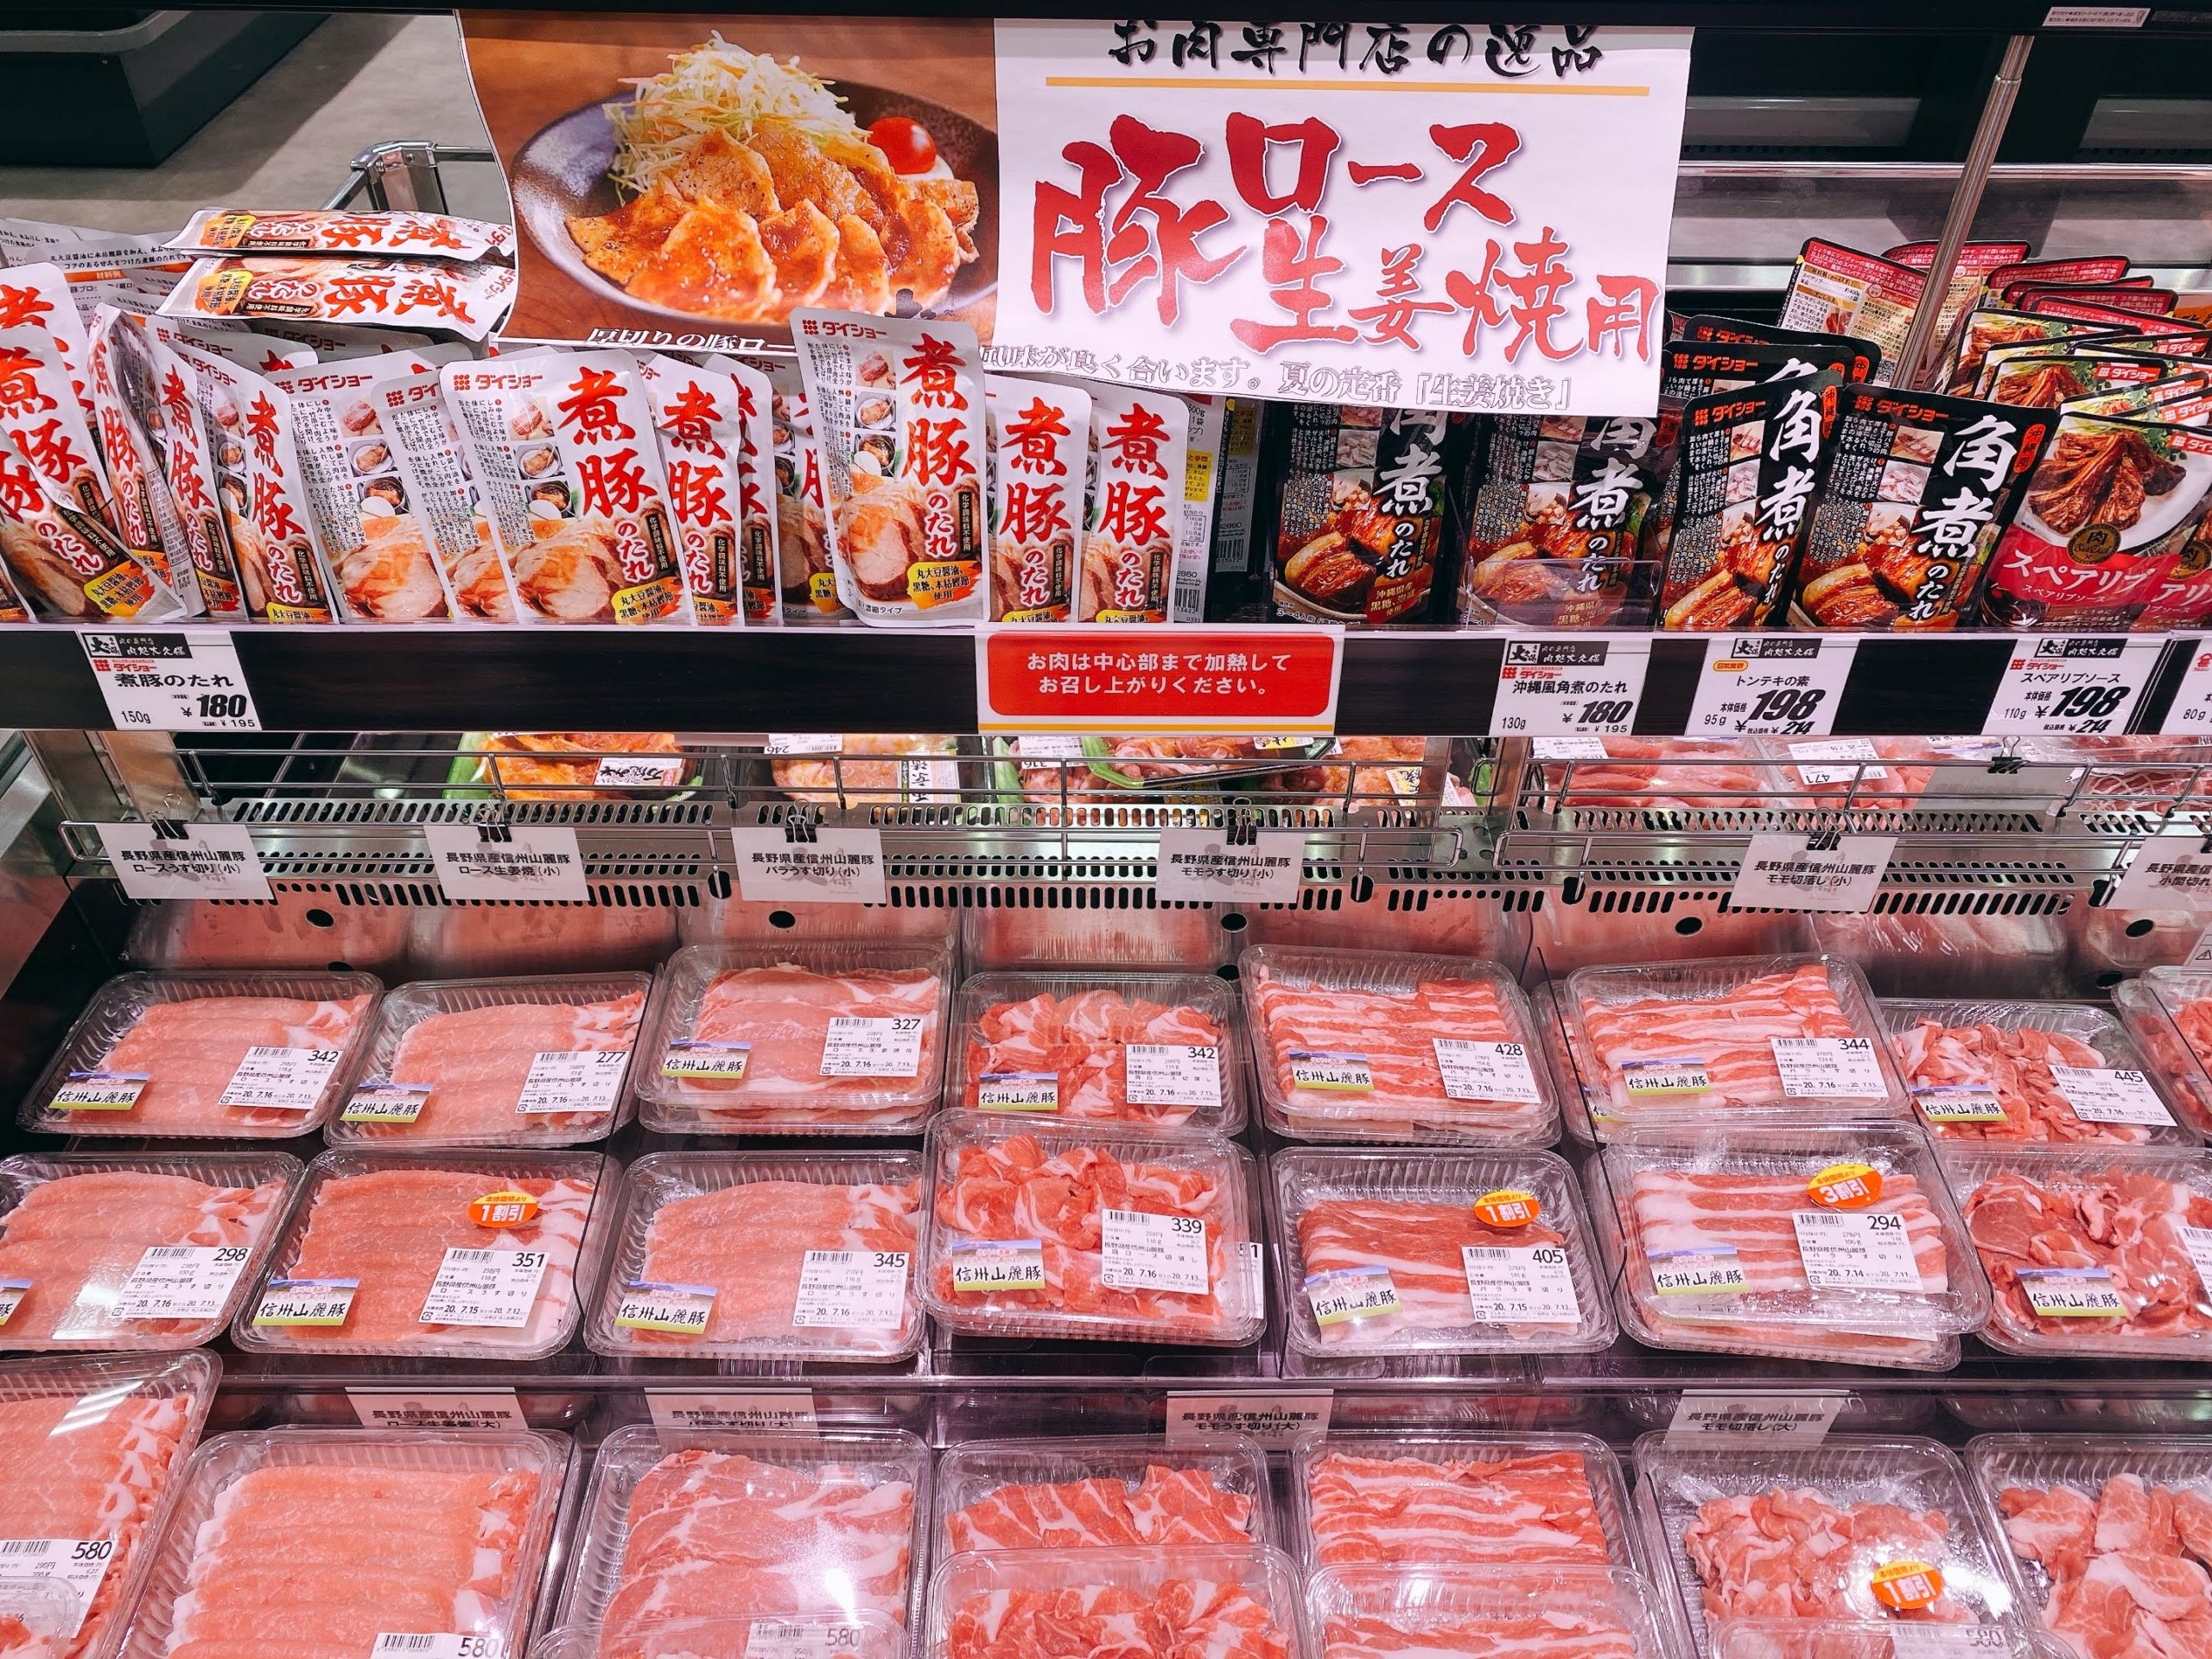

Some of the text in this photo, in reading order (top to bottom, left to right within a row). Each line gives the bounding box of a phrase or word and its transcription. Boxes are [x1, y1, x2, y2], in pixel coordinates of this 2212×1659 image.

[1230, 218, 1663, 365] 生姜焼用
[822, 321, 887, 339] ダイショー
[1692, 353, 1759, 372] ダイショー
[297, 374, 373, 393] ダイショー
[474, 374, 543, 390] ダイショー
[1876, 398, 1949, 422] ダイショー
[1027, 652, 1292, 672] お肉は中心部まで加熱して
[114, 673, 234, 688] 煮豚のたれ
[1038, 676, 1267, 695] お召し上がりください。
[1512, 680, 1628, 695] 沖縄風角煮のたれ
[1736, 675, 1810, 687] トンテキの素
[1748, 690, 1826, 721] 198
[2049, 686, 2132, 717] 198
[121, 710, 152, 724] 150g
[1501, 716, 1527, 731] 130g
[120, 849, 247, 863] 長野県産信州山麗豚
[445, 851, 572, 865] 長野県産信州山麗豚
[752, 852, 875, 866] 長野県産信州山麗豚
[1170, 854, 1291, 868] 長野県産信州山麗豚
[1754, 861, 1876, 875] 長野県産信州山麗豚
[892, 1019, 921, 1030] 327
[1494, 1044, 1523, 1056] 428
[1839, 1039, 1870, 1050] 344
[308, 1050, 340, 1063] 342
[596, 1052, 626, 1064] 277
[1187, 1047, 1215, 1059] 342
[665, 1058, 742, 1072] 信州山麗豚
[1295, 1070, 1370, 1084] 信州山麗豚
[1628, 1076, 1707, 1090] 信州山麗豚
[2114, 1071, 2145, 1083] 445
[56, 1090, 136, 1104] 信州山麗豚
[981, 1091, 1056, 1104] 信州山麗豚
[346, 1102, 419, 1115] 信州山麗豚
[1925, 1103, 2001, 1116] 信州山麗豚
[1171, 1217, 1203, 1233] 339
[1867, 1216, 1901, 1230] 294
[213, 1248, 248, 1262] 298
[512, 1253, 544, 1268] 351
[874, 1253, 906, 1268] 345
[1532, 1249, 1563, 1263] 405
[956, 1266, 1041, 1281] 信州山麗豚
[1657, 1270, 1743, 1287] 信州山麗豚
[1315, 1290, 1396, 1315] 信州山麗豚
[2032, 1293, 2120, 1308] 信州山麗豚
[260, 1303, 346, 1318] 信州山麗豚
[620, 1304, 706, 1325] 信州山麗豚
[71, 1541, 112, 1559] 580
[457, 1637, 499, 1658] 580
